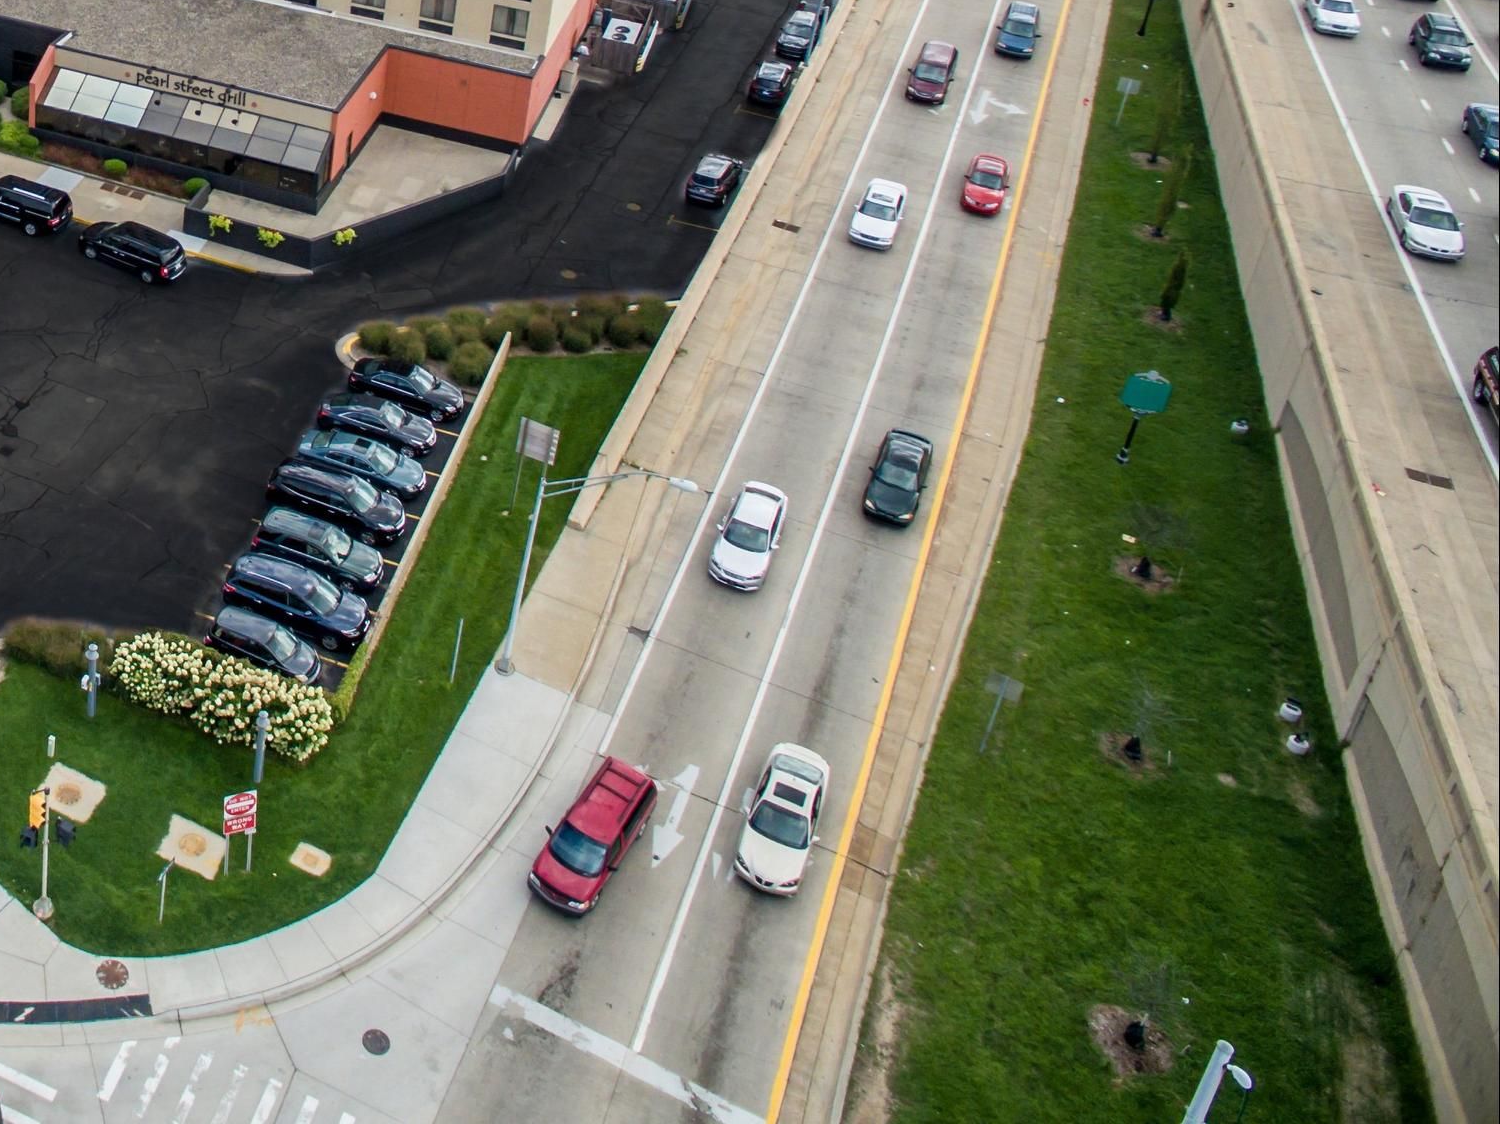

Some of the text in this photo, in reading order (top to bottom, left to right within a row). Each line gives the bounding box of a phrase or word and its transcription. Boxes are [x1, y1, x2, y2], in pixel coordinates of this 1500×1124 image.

[136, 72, 247, 106] pearl street grill
[230, 805, 250, 814] ENTER
[227, 816, 252, 826] WRONG
[231, 823, 247, 831] WAY
